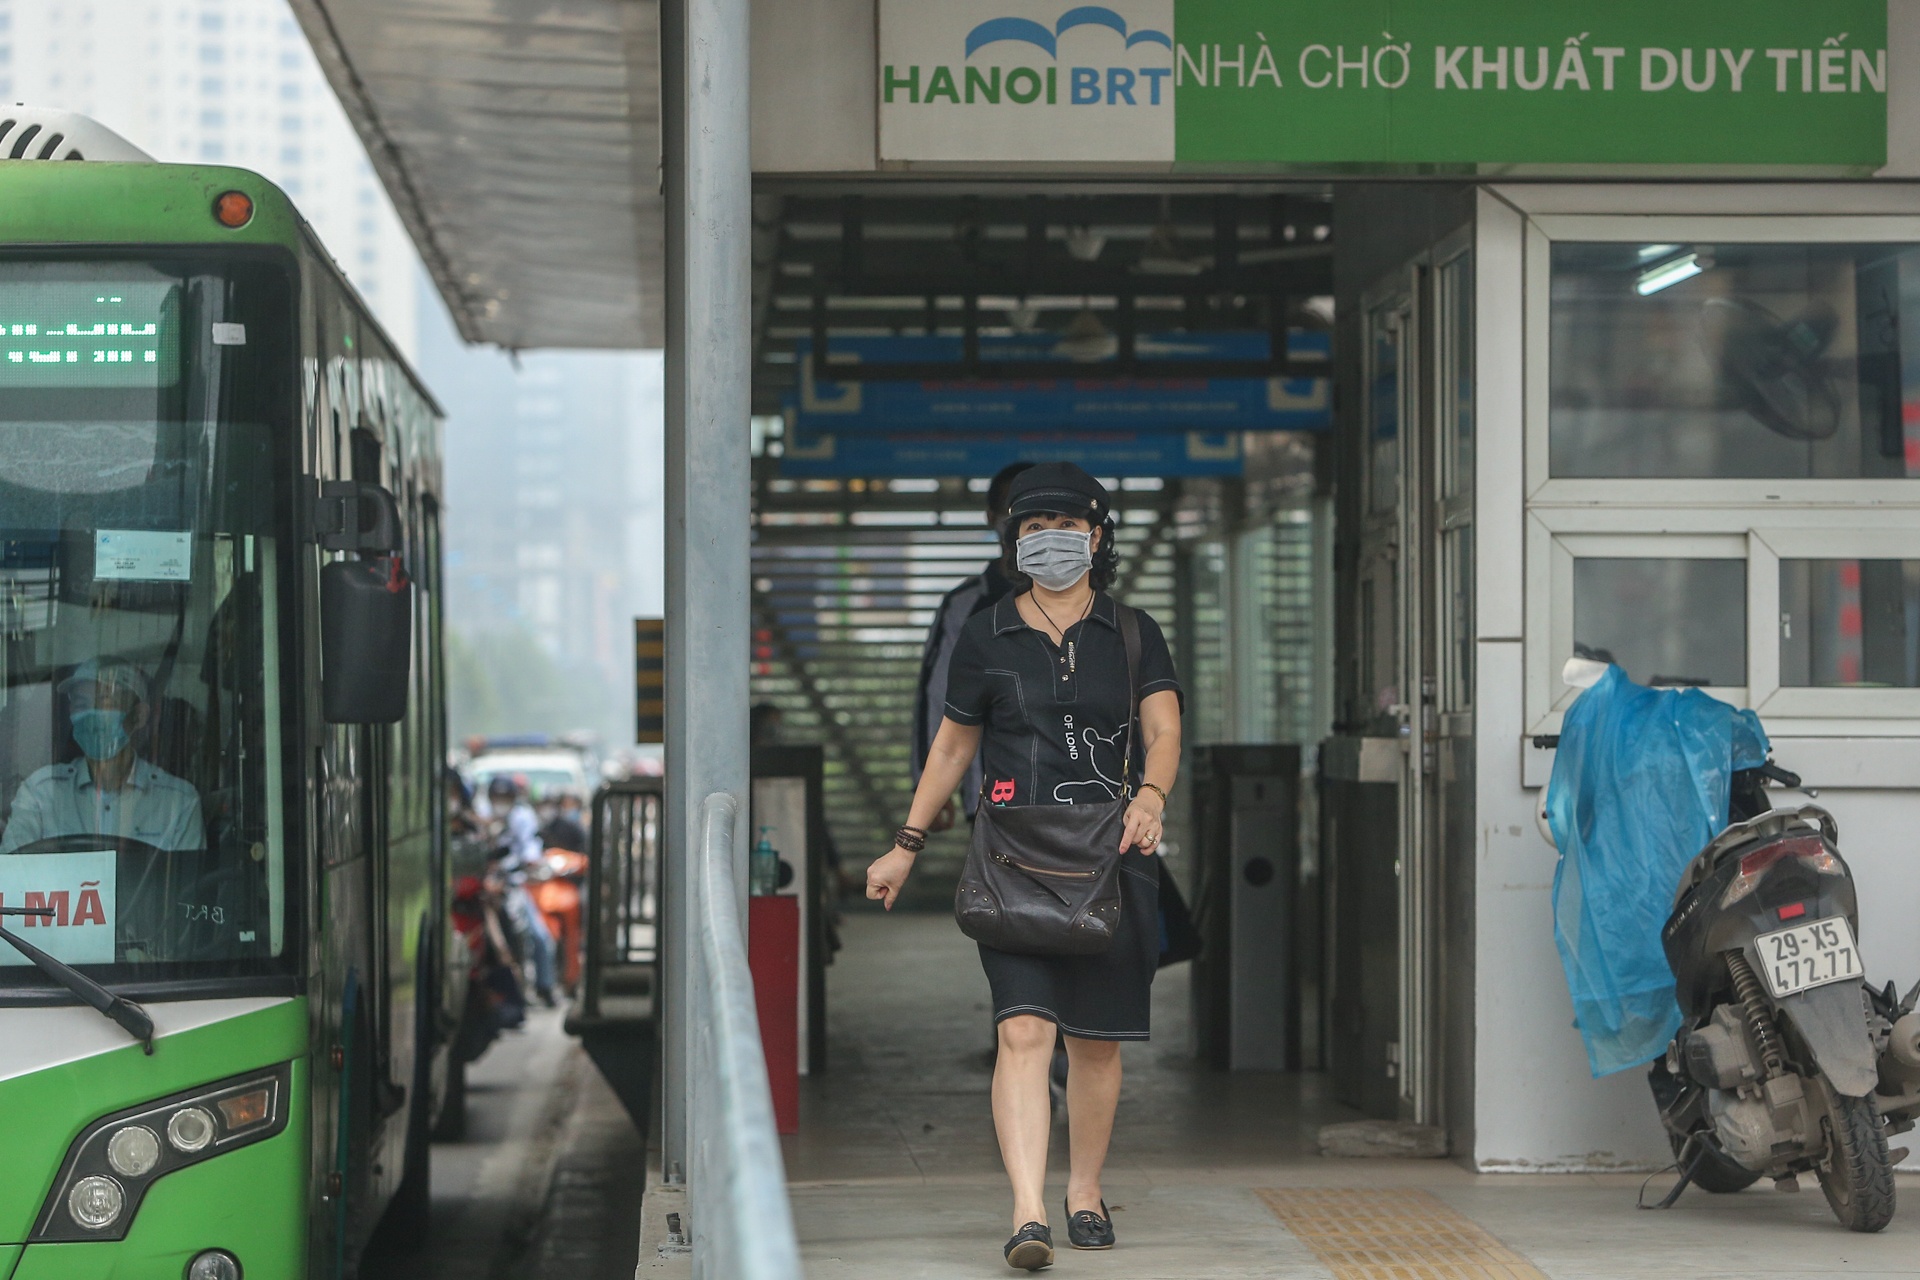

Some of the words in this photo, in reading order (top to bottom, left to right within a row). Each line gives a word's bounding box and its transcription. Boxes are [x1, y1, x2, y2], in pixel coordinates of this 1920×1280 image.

[1176, 32, 1283, 88] NHÀ
[1299, 31, 1412, 89] CHỜ
[1435, 32, 1625, 91] KHUẤT
[1640, 48, 1755, 93] DUY
[1766, 33, 1886, 93] TIẾN
[884, 65, 1057, 104] HANOI
[1071, 67, 1172, 106] BRT
[1063, 714, 1074, 730] OF
[1065, 731, 1079, 760] LOND
[24, 880, 106, 928] MÃ
[1770, 922, 1839, 961] 29-X5
[1775, 947, 1851, 990] 472.77
